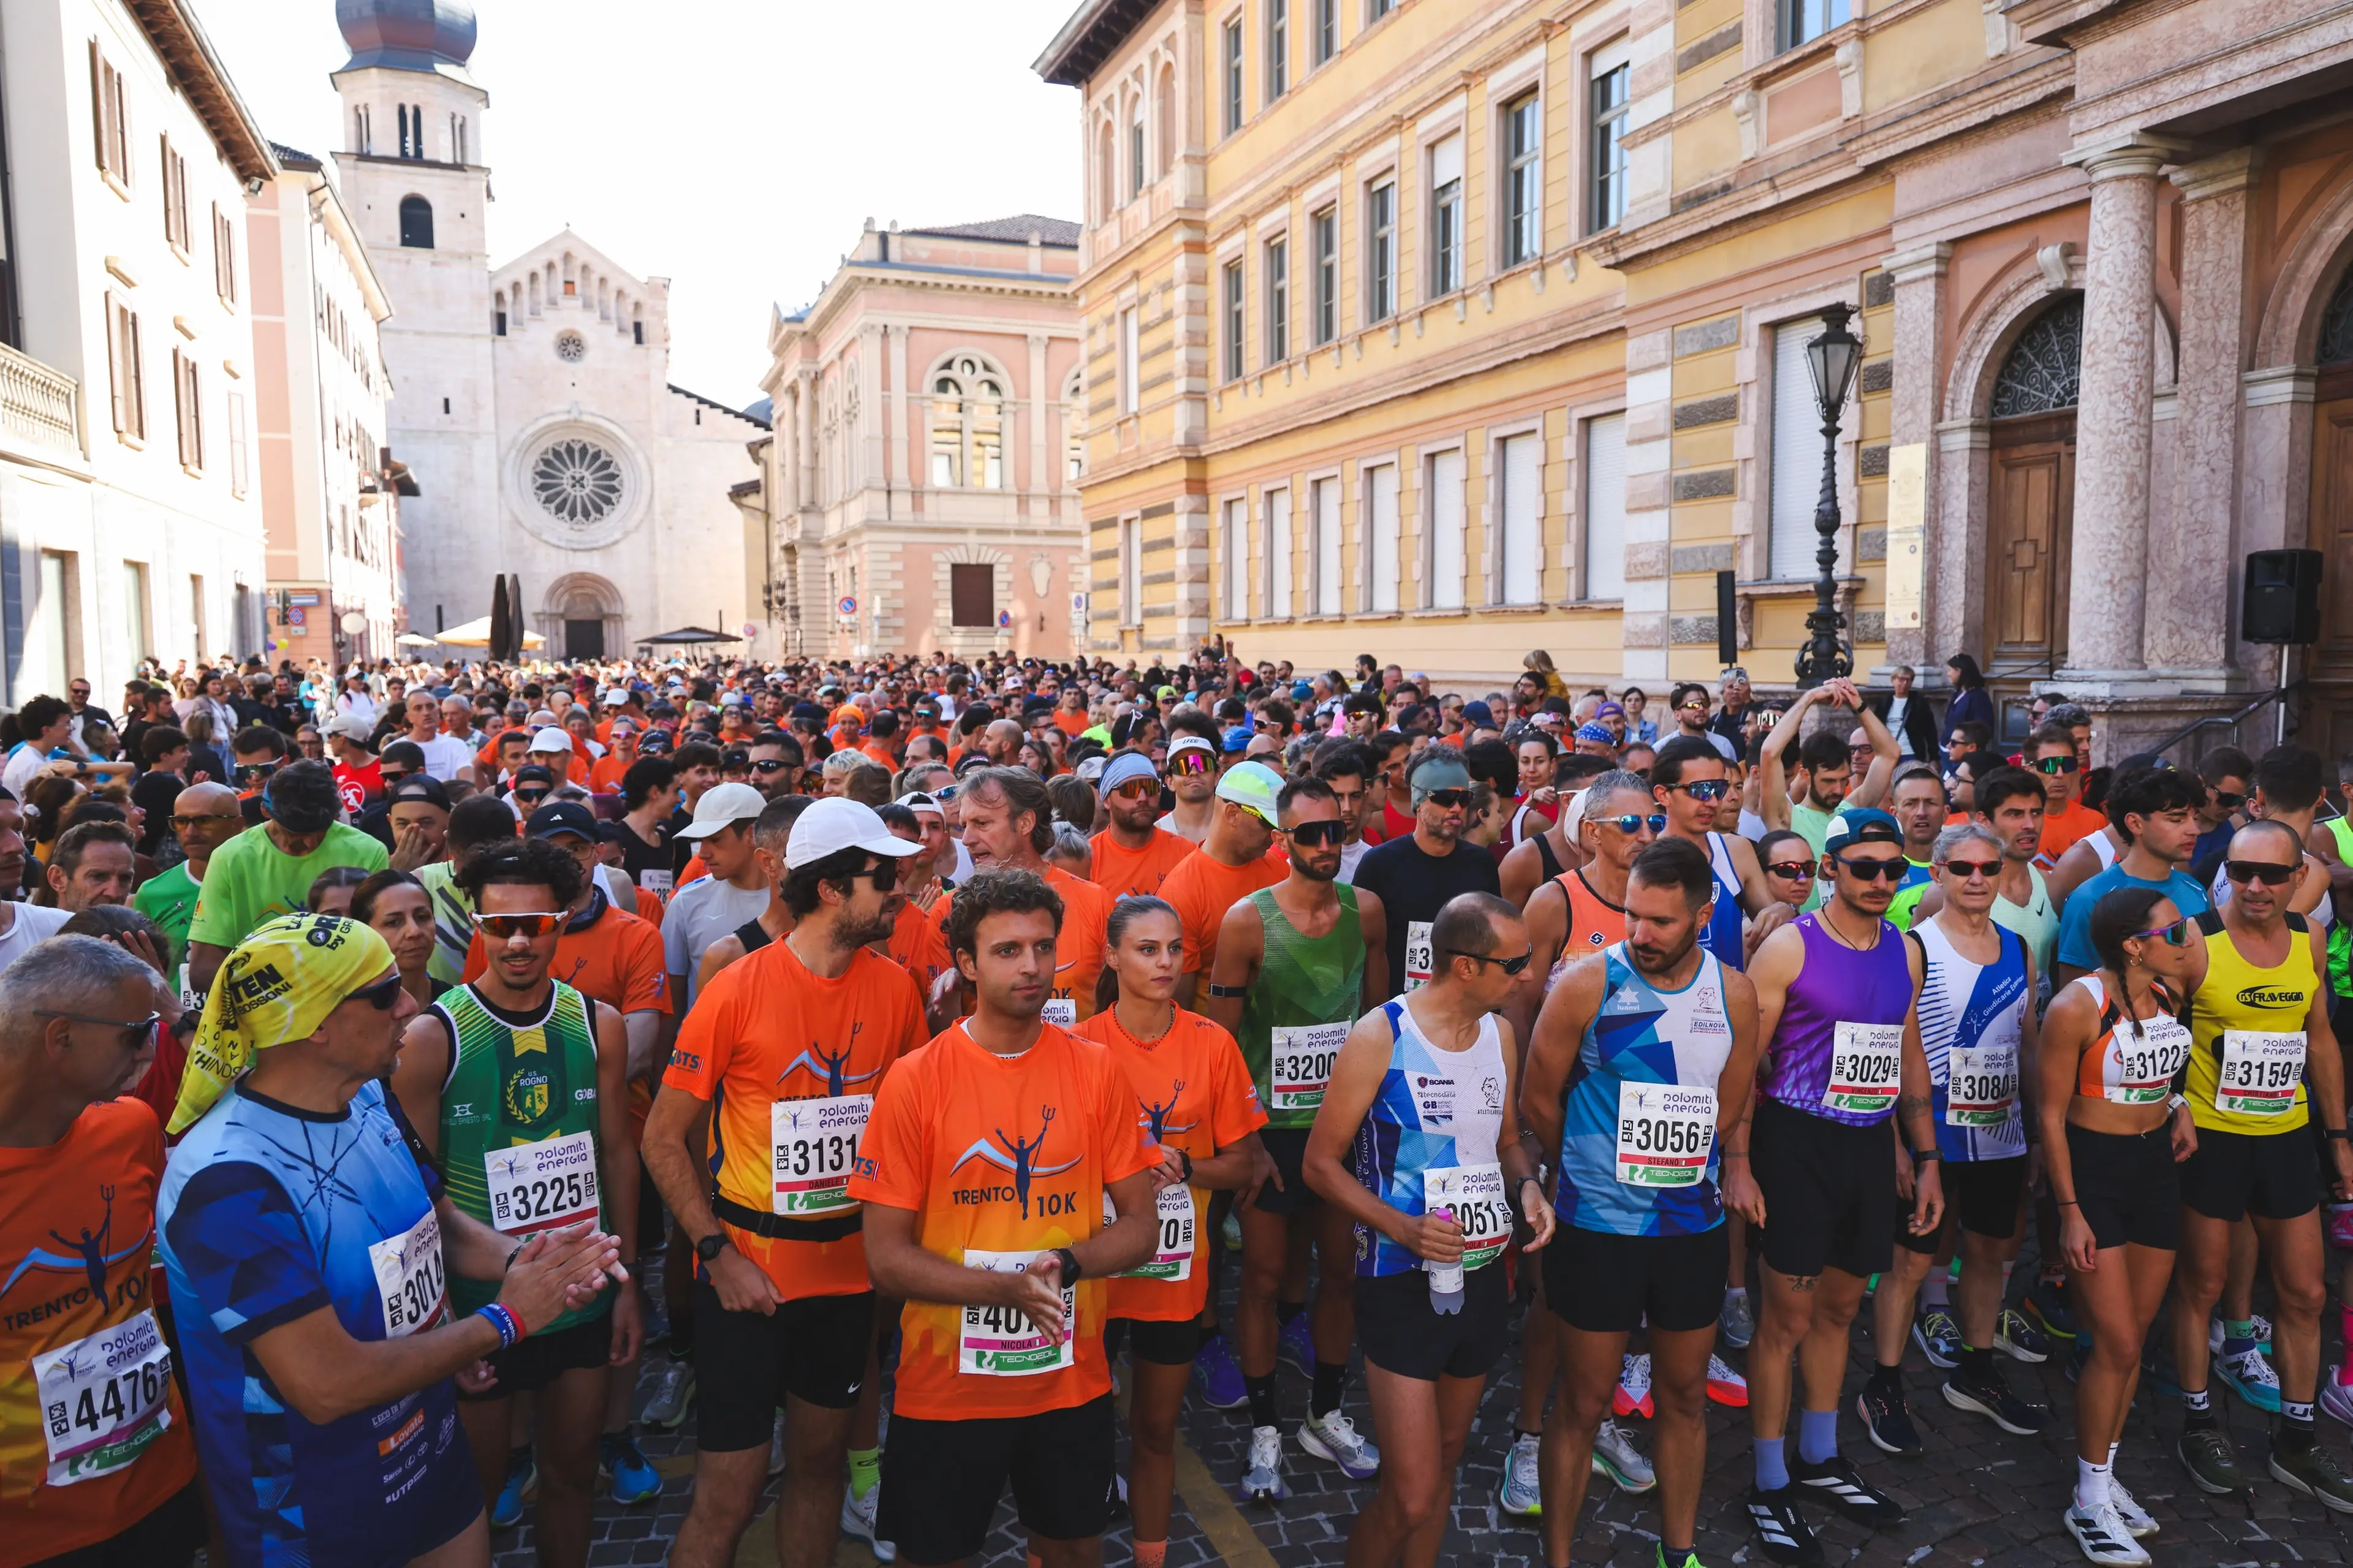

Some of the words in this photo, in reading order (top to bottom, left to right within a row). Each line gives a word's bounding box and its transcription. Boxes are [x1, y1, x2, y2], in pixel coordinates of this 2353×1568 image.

[1991, 976, 2012, 996] Atletica
[2253, 991, 2304, 1002] FRAVEGGIO
[1042, 1005, 1069, 1015] omiti
[1982, 989, 2012, 1017] Giudicarie
[1287, 1051, 1338, 1081] 3200
[1846, 1054, 1892, 1083] 3029
[2137, 1045, 2180, 1080] 3122
[2238, 1061, 2293, 1088] 3159
[520, 1075, 548, 1087] ROGNO
[1964, 1074, 2010, 1101] 3080
[1423, 1100, 1438, 1109] GB
[1636, 1118, 1700, 1154] 3056
[793, 1134, 857, 1176] 3131
[1647, 1157, 1679, 1167] STEFANO
[512, 1172, 582, 1221] 3225
[808, 1177, 840, 1189] DANIELE
[1159, 1188, 1188, 1202] lomiti
[952, 1186, 1015, 1205] TRENTO
[1037, 1191, 1077, 1218] 10K
[1159, 1200, 1189, 1211] ergia
[1463, 1249, 1496, 1262] ECNOEDIL
[404, 1249, 443, 1325] 3014
[5, 1287, 89, 1331] TRENTO
[1000, 1339, 1033, 1350] NICOLA
[75, 1361, 158, 1432] 4476
[389, 1414, 424, 1450] Lovato
[399, 1424, 425, 1452] electric
[383, 1466, 403, 1484] Sarco
